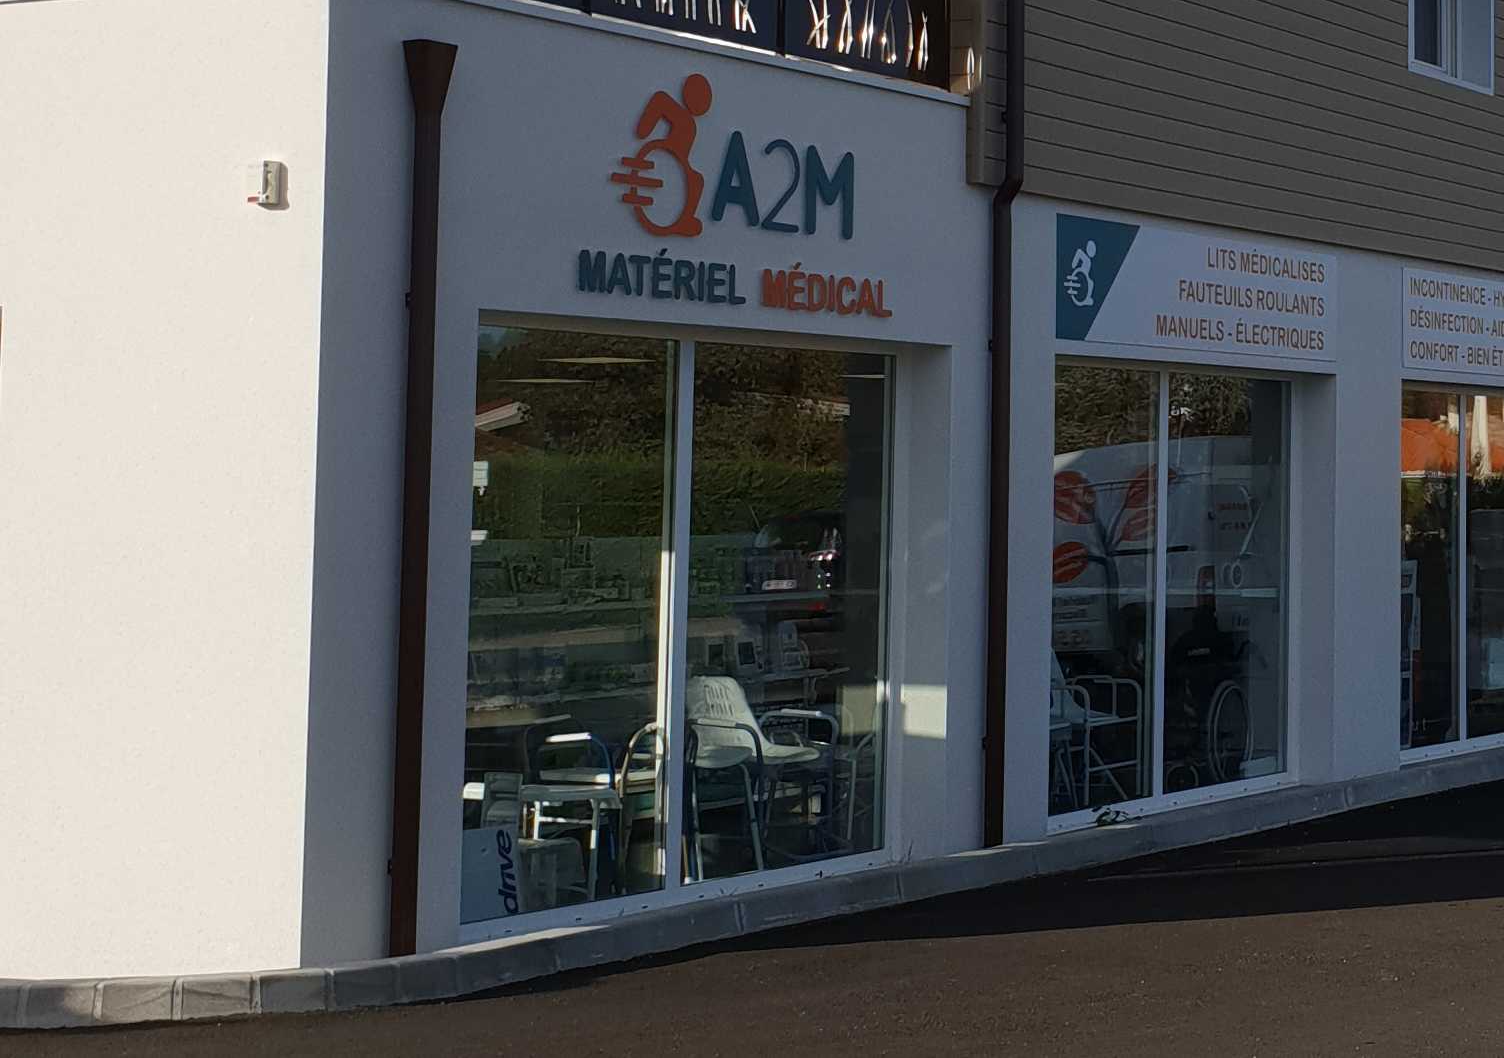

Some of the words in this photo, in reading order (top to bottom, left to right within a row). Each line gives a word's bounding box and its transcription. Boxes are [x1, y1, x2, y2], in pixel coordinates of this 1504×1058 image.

[711, 130, 854, 240] A2M
[1207, 246, 1236, 270] LITS
[576, 247, 746, 305] MATÉRIEL
[759, 261, 892, 318] MÉDICAL
[1178, 279, 1253, 308] FAUTEUILS
[1256, 289, 1325, 317] ROULANTS
[1409, 277, 1486, 305] INCONTINENCE
[1155, 314, 1225, 341] MANUELS
[1235, 318, 1324, 351] ÉLECTRIQUES
[1409, 305, 1484, 334] DÉSINFECTION
[1409, 340, 1459, 363] CONFORT
[1467, 346, 1490, 365] BIEN
[496, 829, 519, 914] drive
